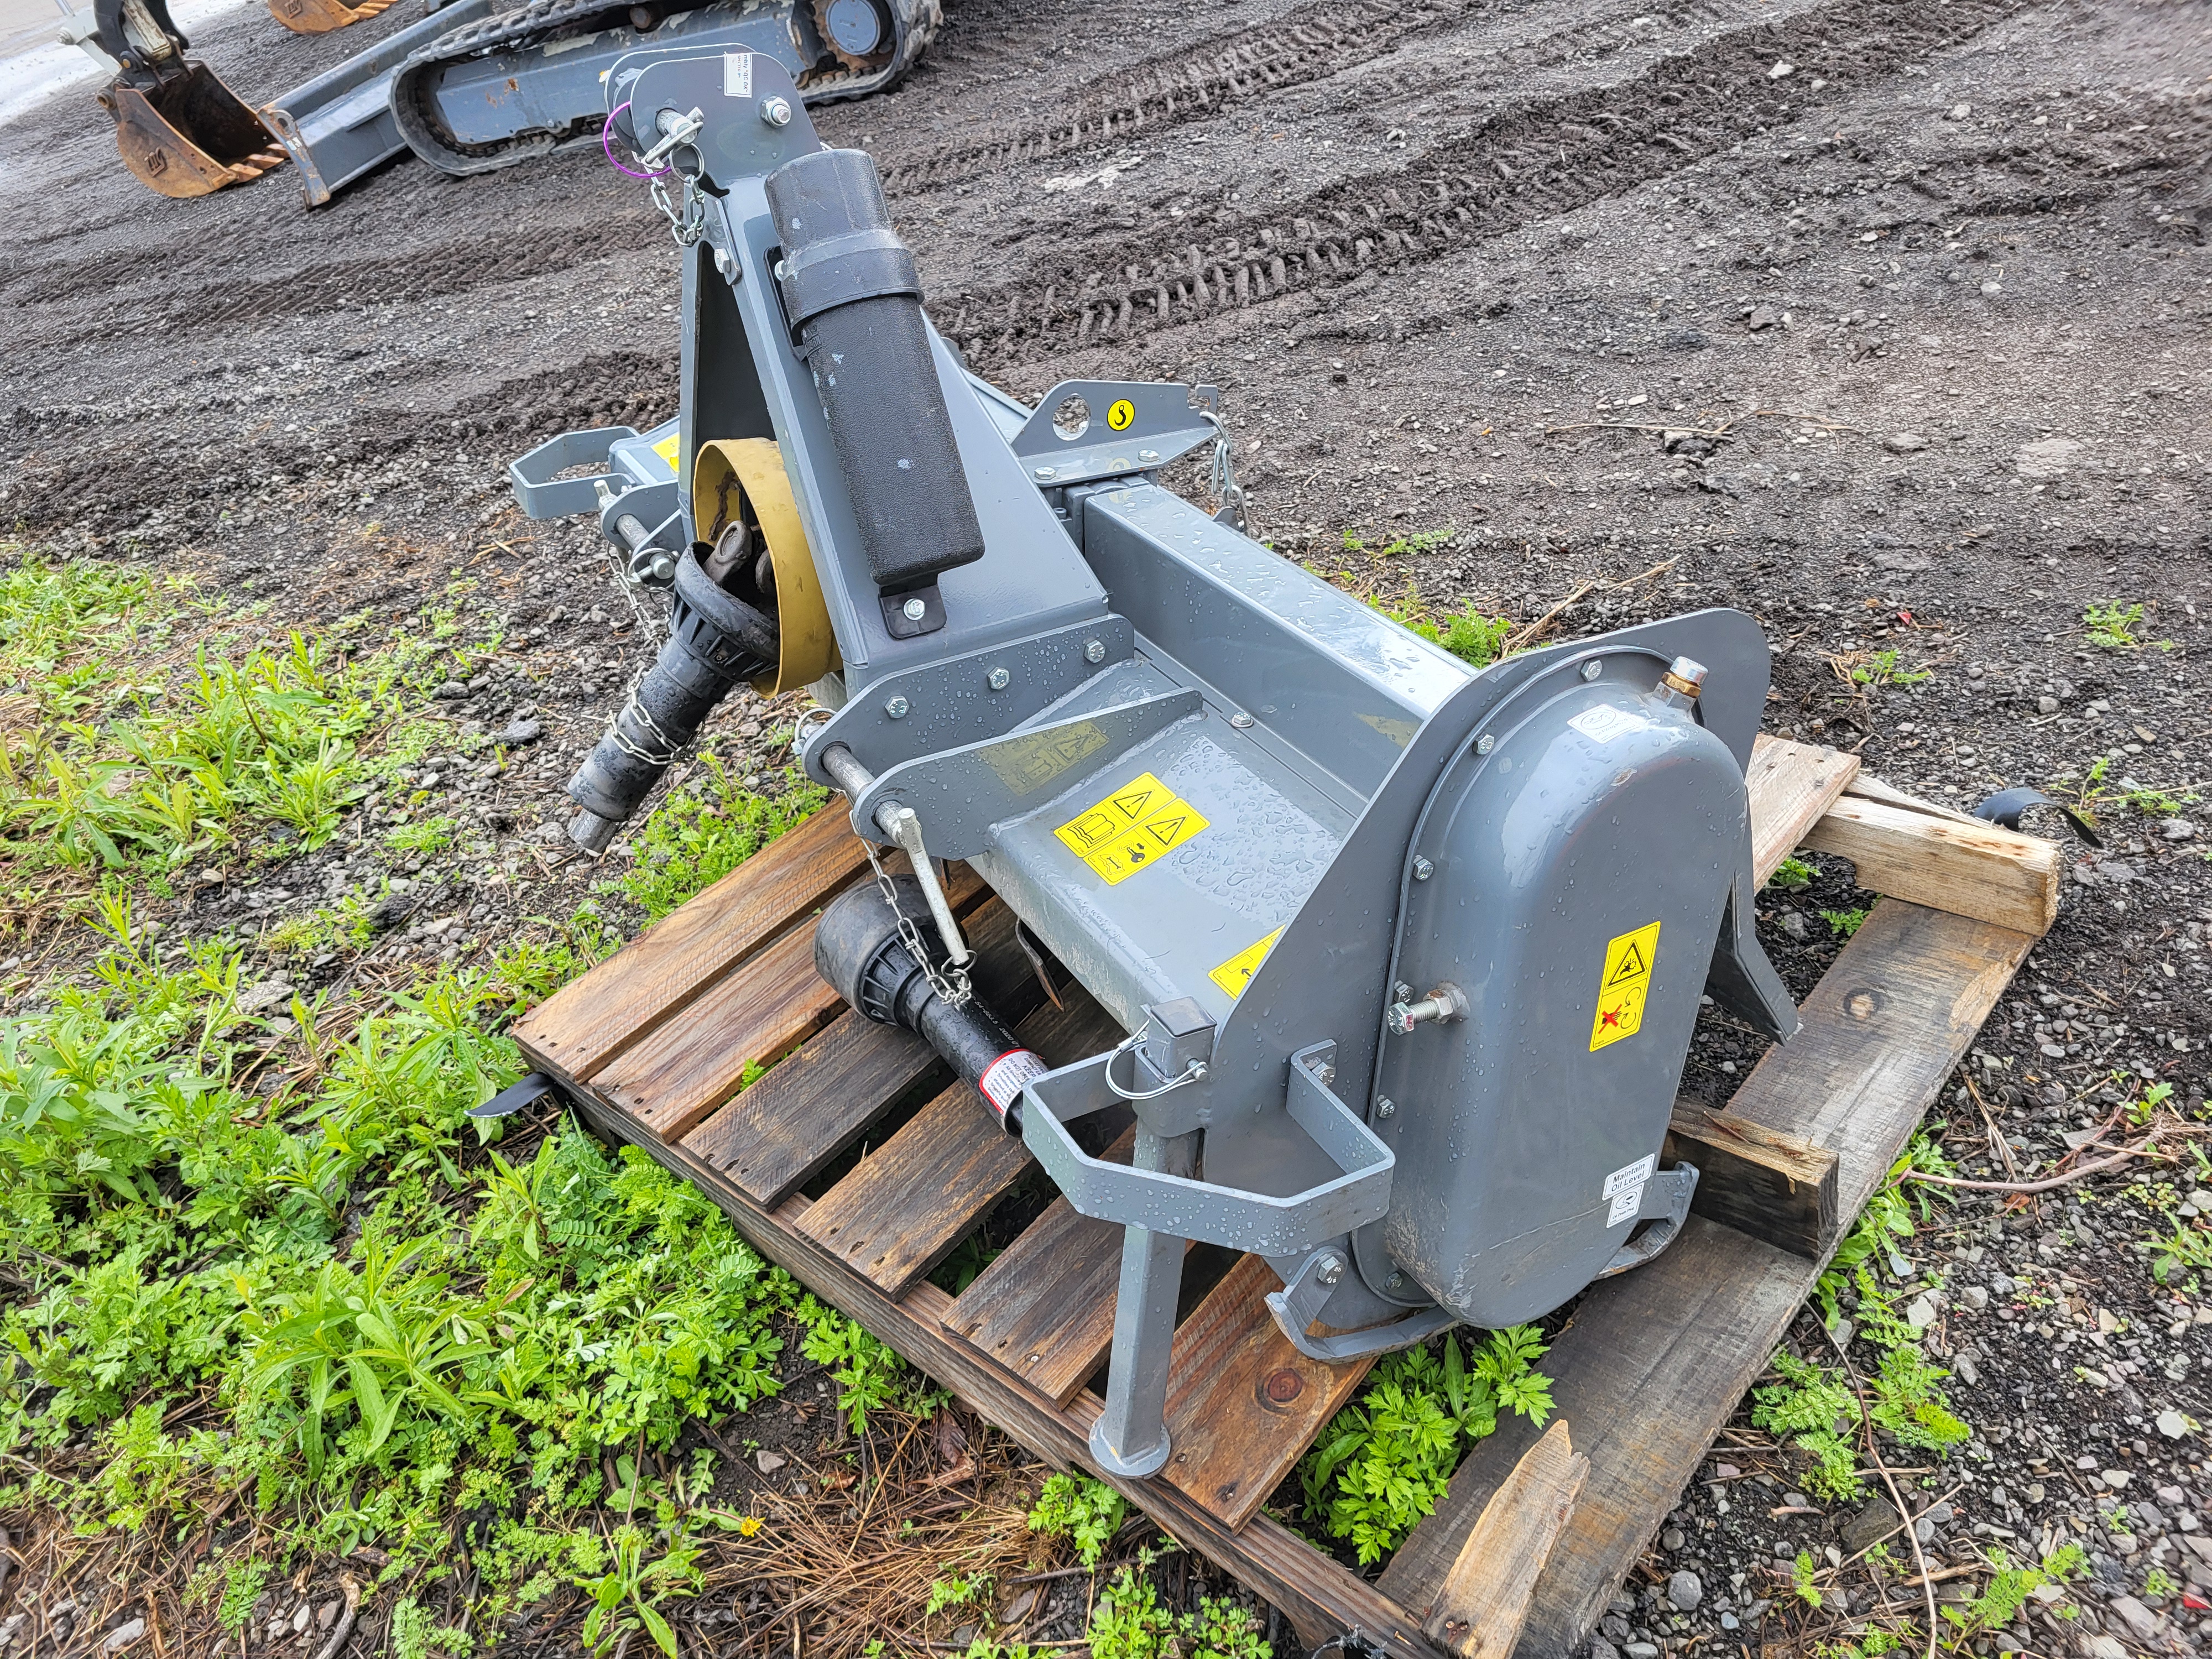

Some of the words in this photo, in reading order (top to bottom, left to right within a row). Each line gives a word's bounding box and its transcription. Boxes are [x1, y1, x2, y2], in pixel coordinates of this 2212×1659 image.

[999, 1027, 1014, 1040] 2020
[1022, 1065, 1037, 1077] KEEP
[1611, 1181, 1623, 1192] Oil
[1624, 1170, 1645, 1186] Level
[1613, 1164, 1645, 1184] Maintain
